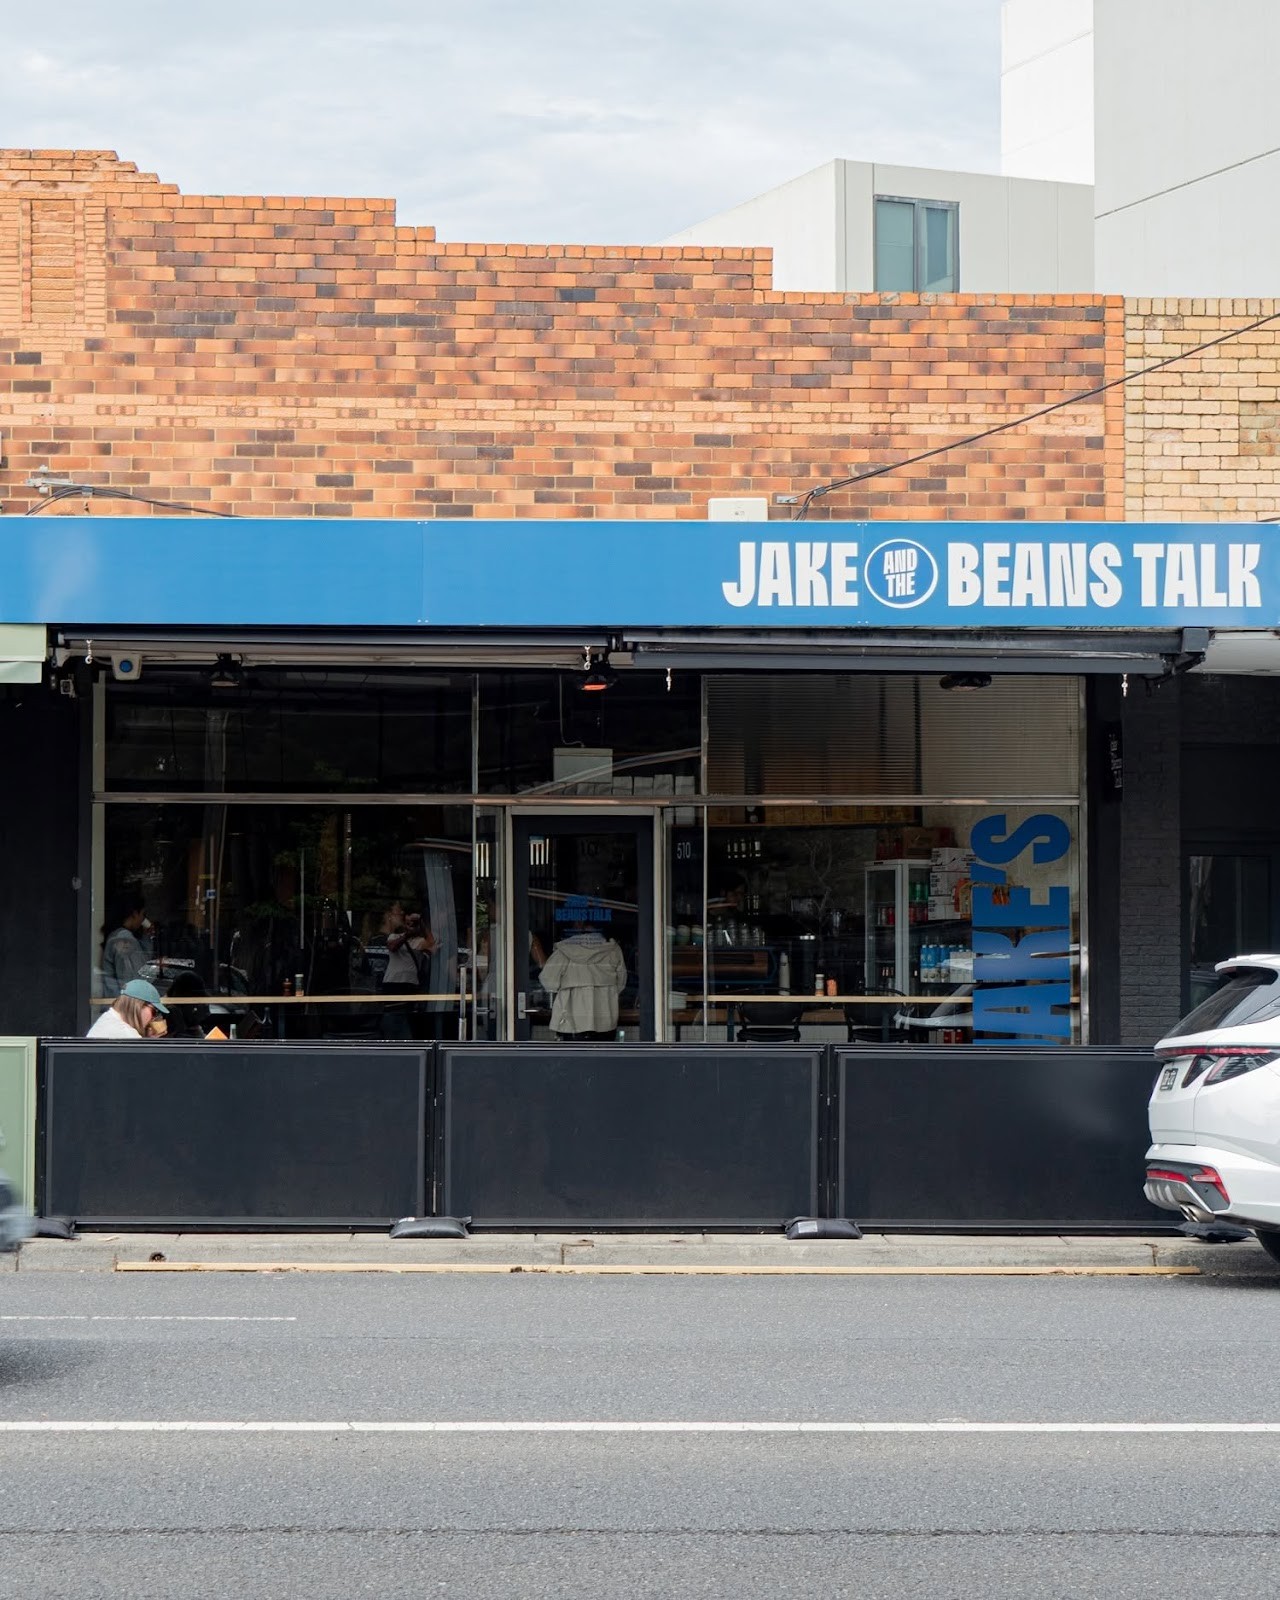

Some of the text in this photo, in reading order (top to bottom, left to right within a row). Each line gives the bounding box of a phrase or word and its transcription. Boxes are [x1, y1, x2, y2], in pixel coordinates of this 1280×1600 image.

[722, 542, 859, 607] JAKE
[883, 548, 918, 575] AND
[947, 542, 1263, 608] BEANS TALK
[885, 572, 916, 598] THE
[676, 841, 692, 859] 510
[970, 813, 1071, 1045] AKE'S
